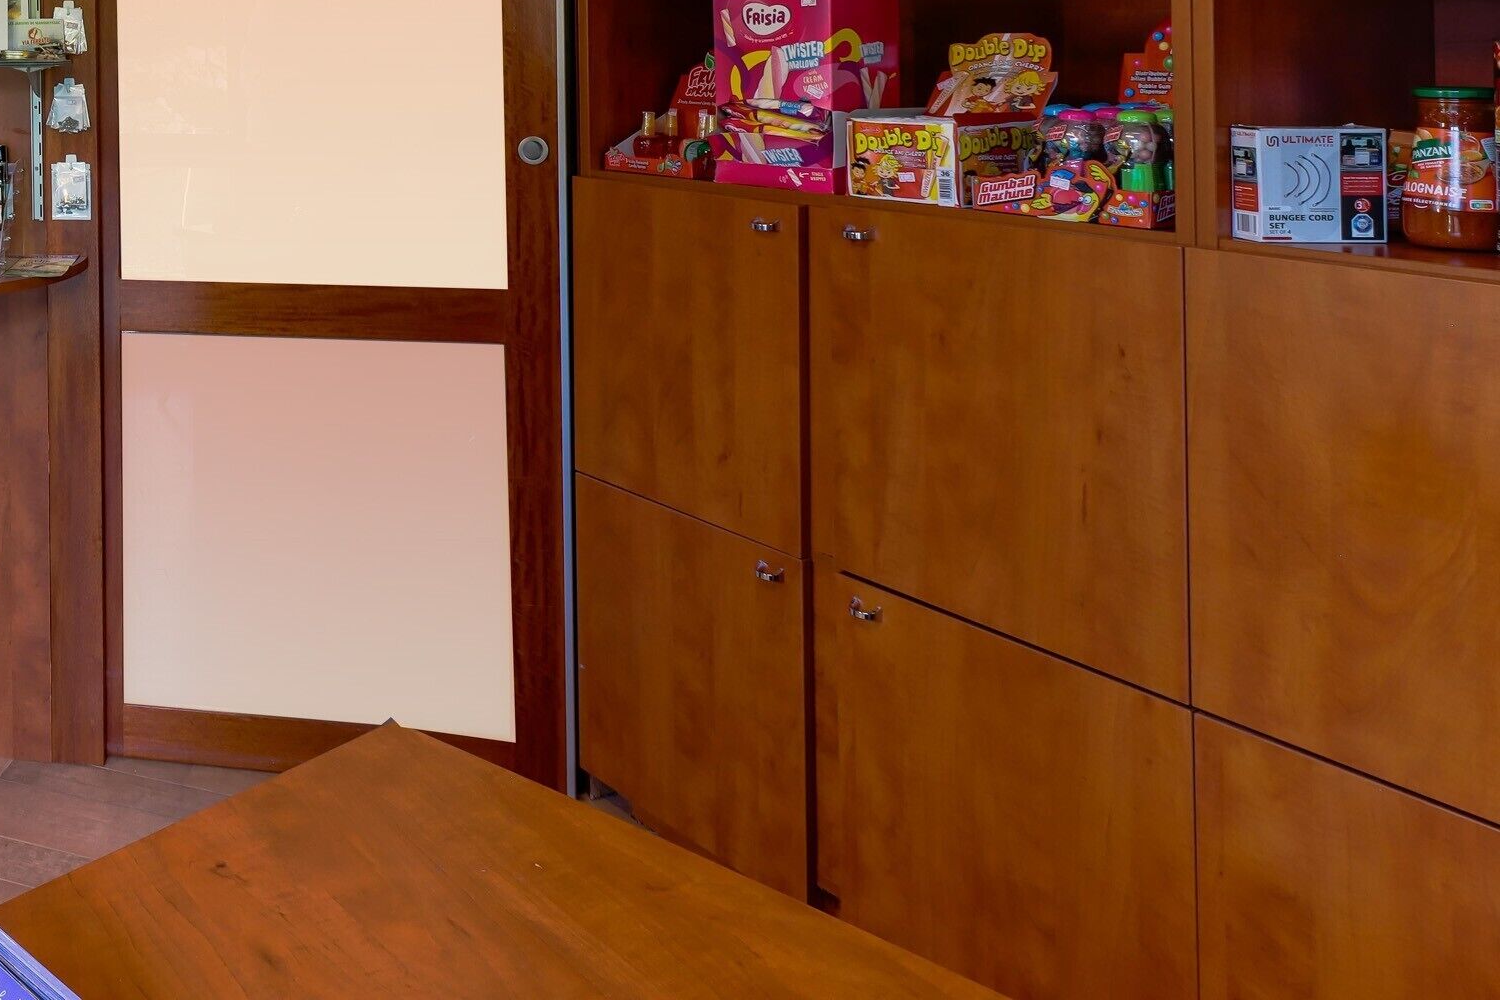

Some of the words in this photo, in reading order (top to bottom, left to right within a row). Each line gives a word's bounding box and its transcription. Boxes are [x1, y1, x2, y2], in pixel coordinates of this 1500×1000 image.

[951, 37, 1010, 66] Double
[1012, 38, 1046, 63] Dip
[855, 128, 913, 154] Double
[1282, 136, 1334, 144] ULTIMATE
[981, 175, 1036, 194] Gumball
[978, 187, 1034, 204] Machine
